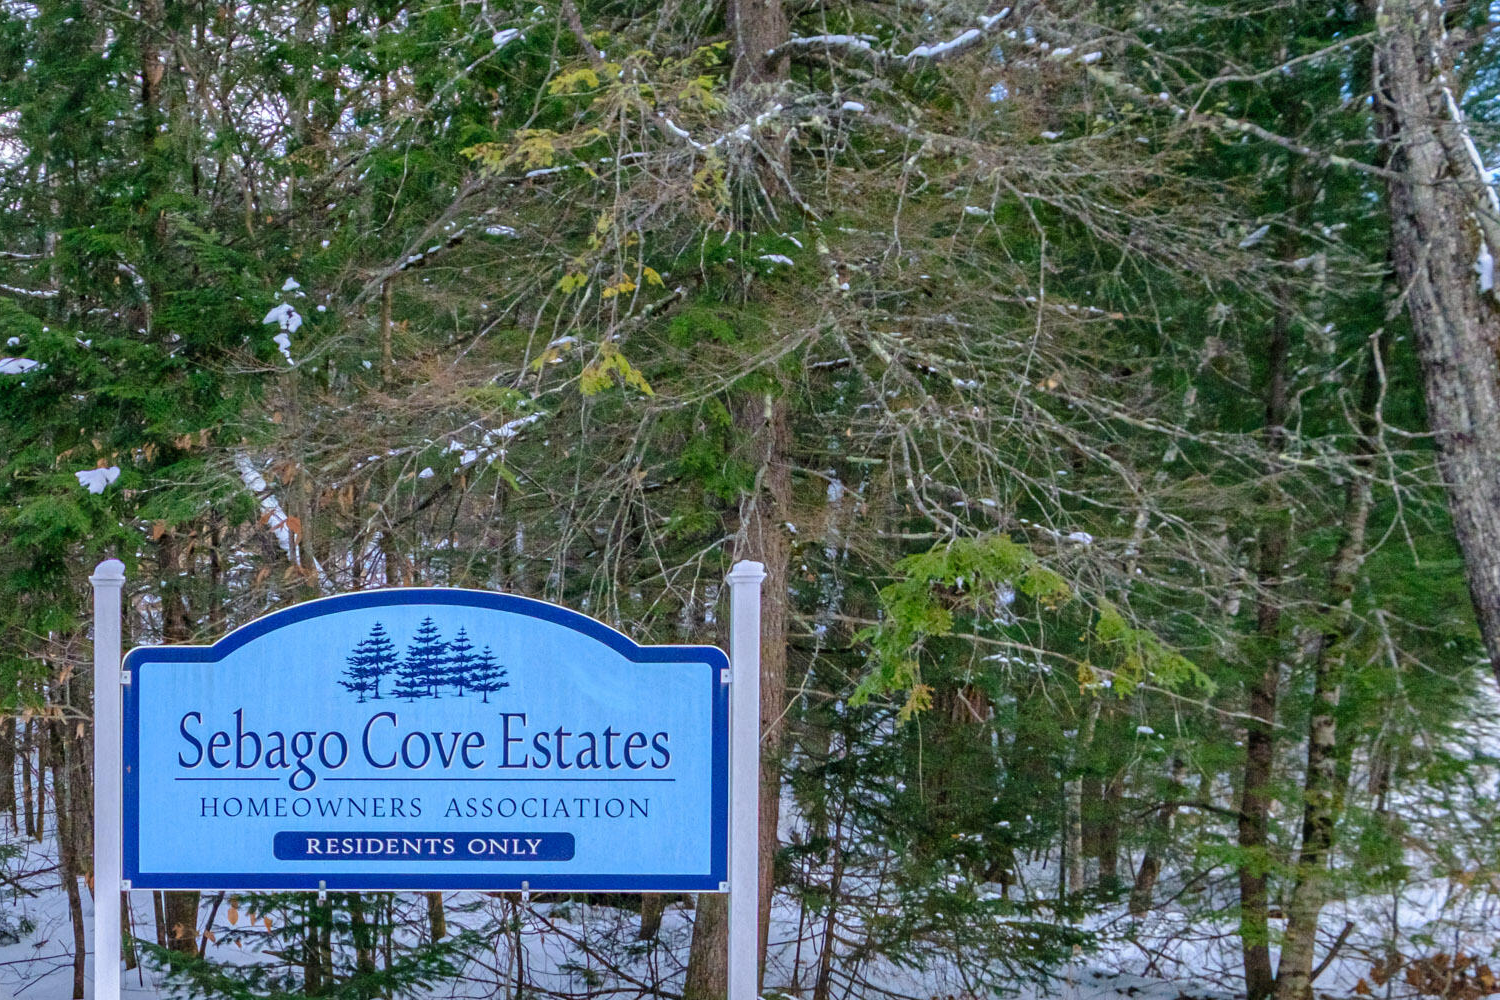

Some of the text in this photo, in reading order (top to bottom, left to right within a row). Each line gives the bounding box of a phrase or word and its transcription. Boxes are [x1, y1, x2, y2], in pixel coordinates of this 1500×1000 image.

[177, 708, 672, 791] Sebago Cove Estates
[199, 797, 651, 819] HOMEOWNERS ASSOCIATION
[306, 837, 543, 856] RESIDENTS ONLY
